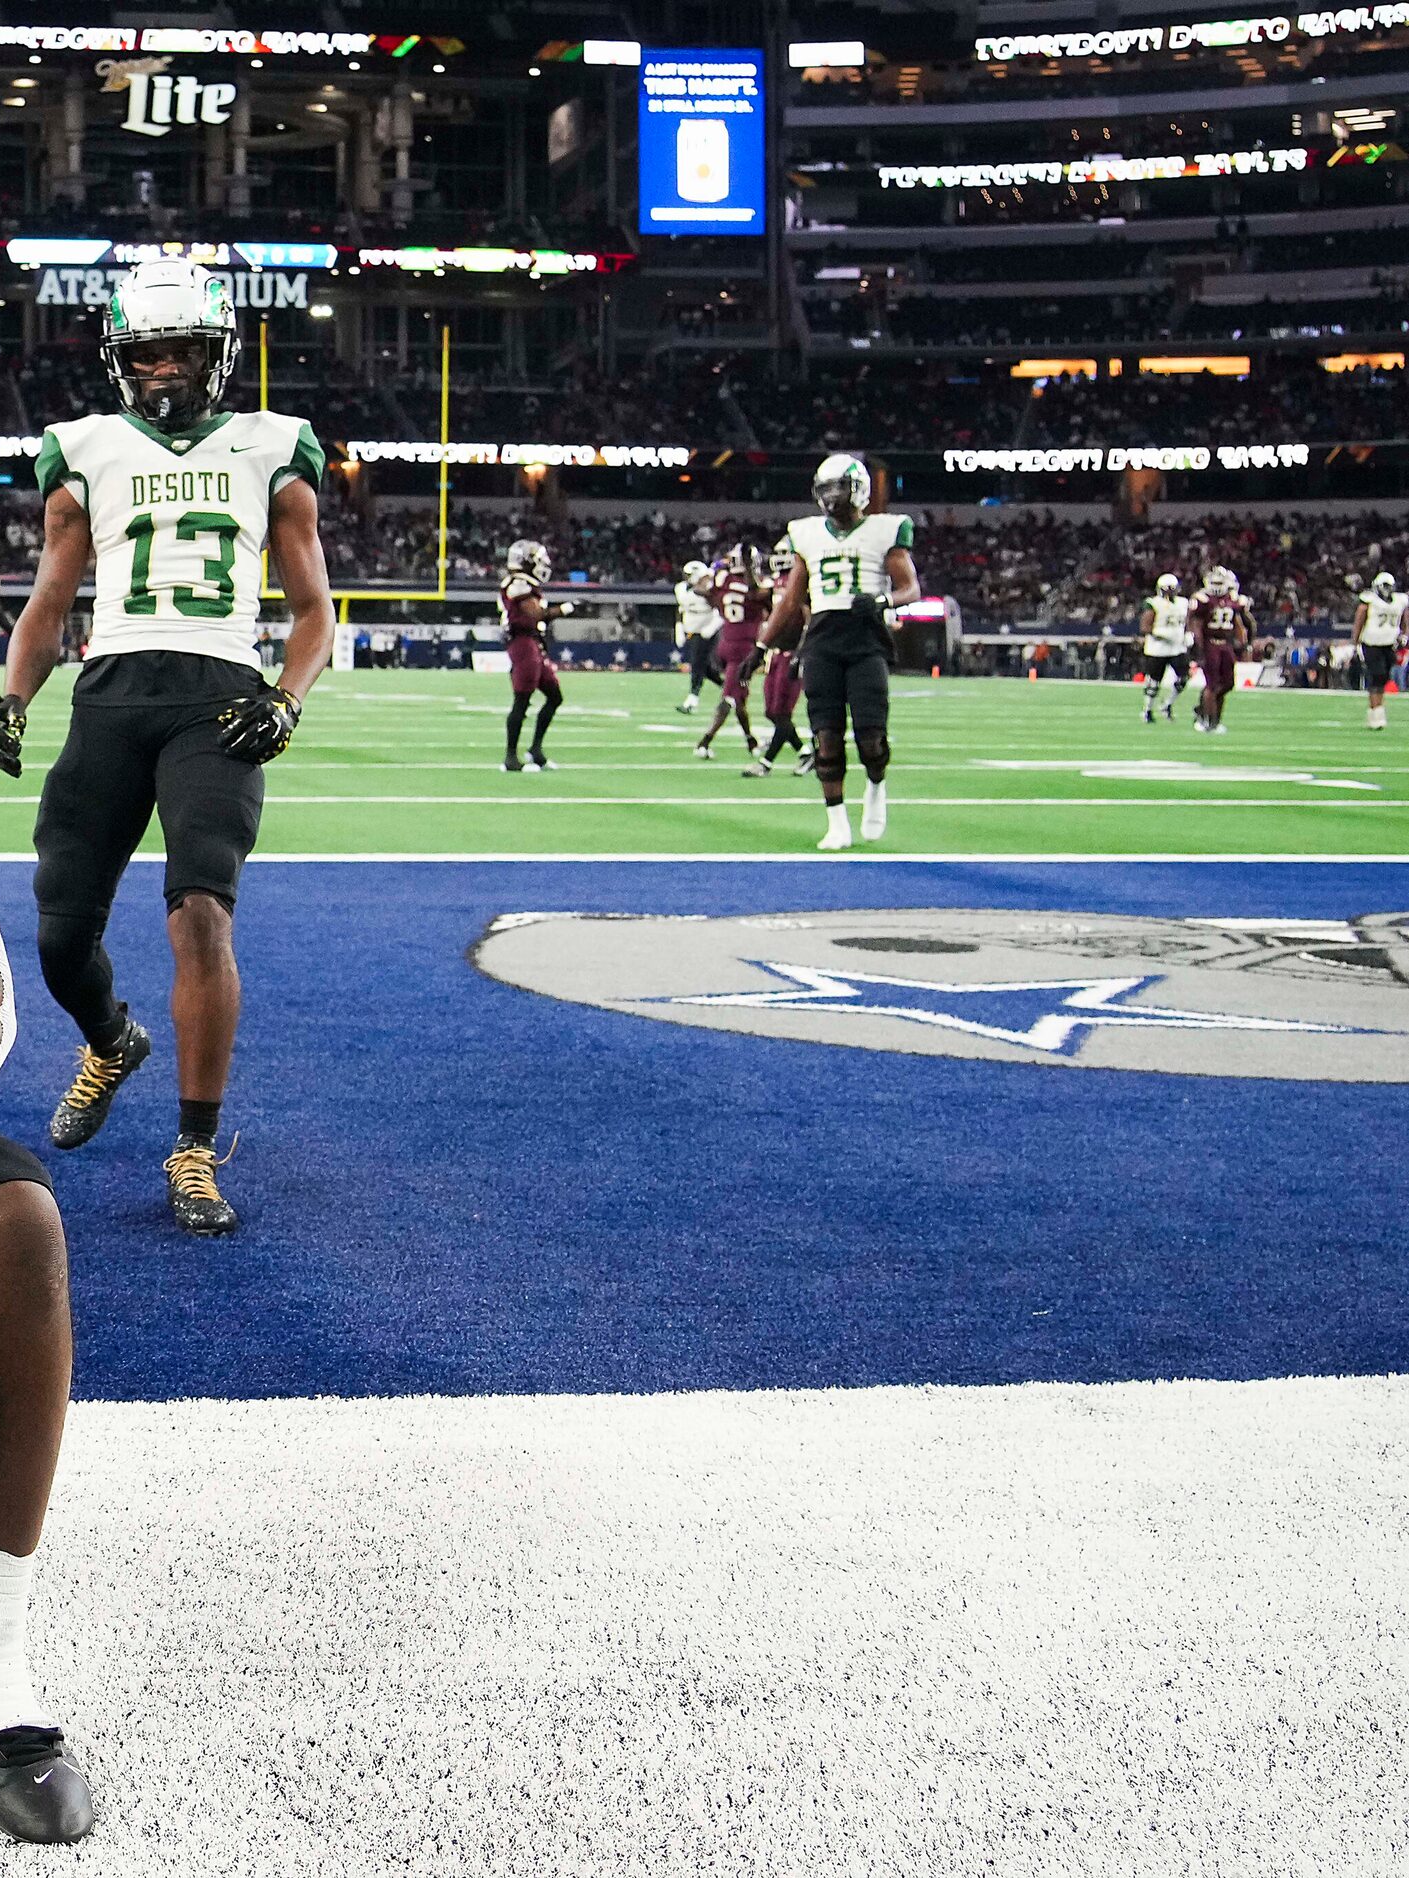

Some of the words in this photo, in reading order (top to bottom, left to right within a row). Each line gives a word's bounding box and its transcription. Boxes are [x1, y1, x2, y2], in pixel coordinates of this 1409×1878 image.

[120, 72, 236, 137] Lite
[210, 271, 308, 308] DIUM
[131, 471, 231, 507] DESOTO
[123, 511, 241, 619] 13
